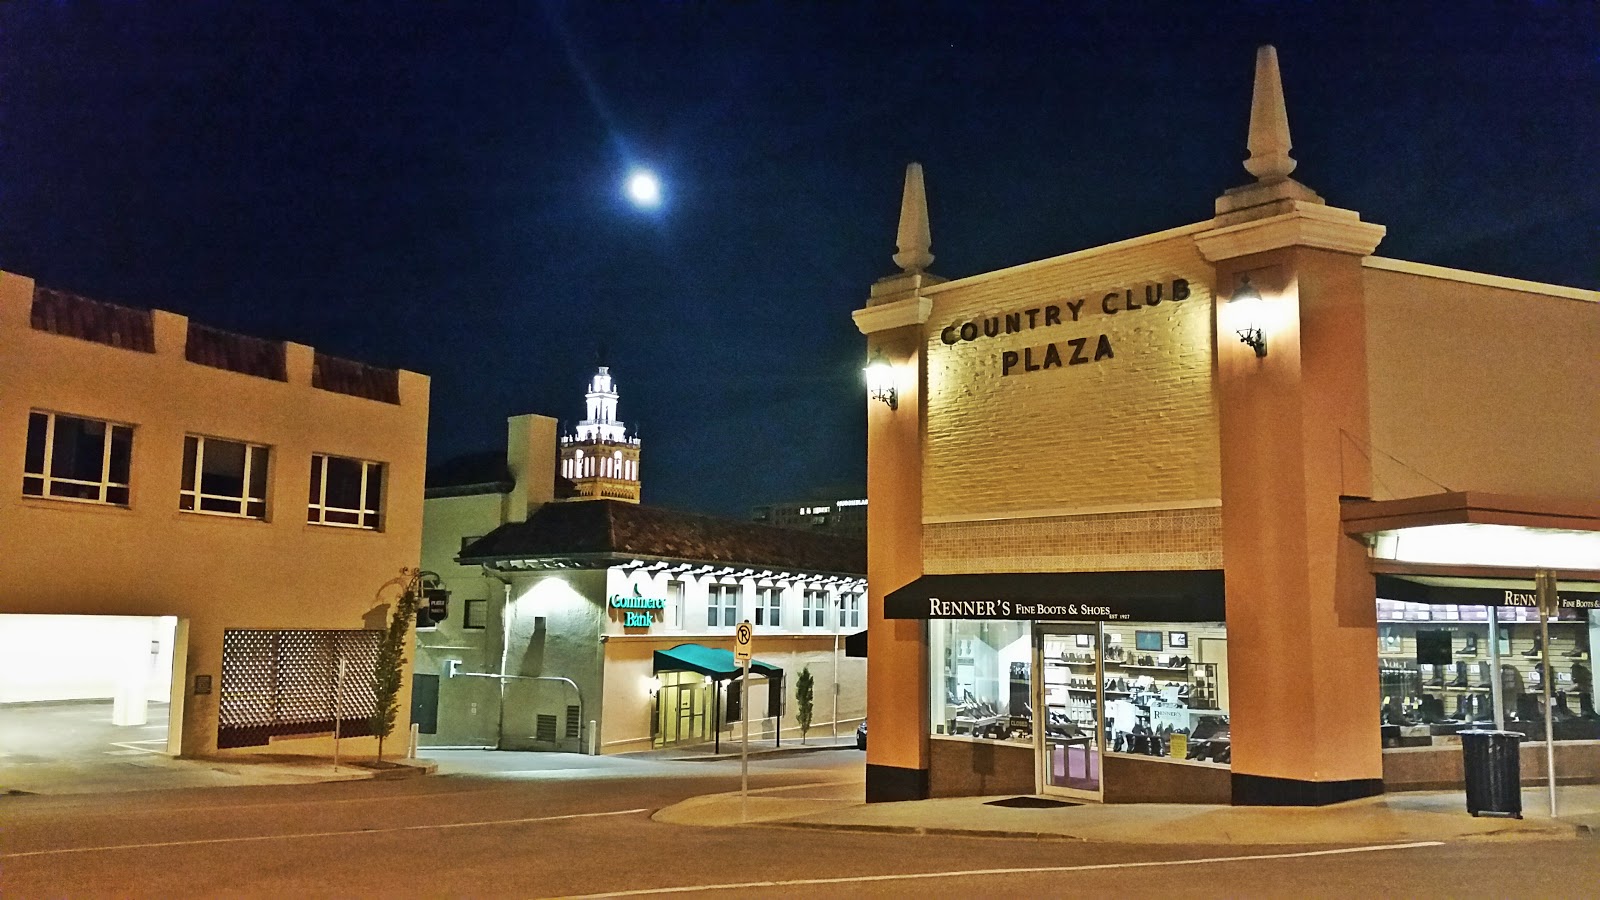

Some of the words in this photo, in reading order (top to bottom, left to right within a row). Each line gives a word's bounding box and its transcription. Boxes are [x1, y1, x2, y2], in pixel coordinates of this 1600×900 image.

[941, 299, 1084, 345] COUNTRY
[1101, 278, 1191, 315] CLUB
[1002, 334, 1114, 376] PLAZA
[609, 594, 666, 609] Commerce
[929, 598, 1011, 616] RENNER'S
[1015, 603, 1036, 615] FINE
[1037, 603, 1067, 615] BOOTS
[1068, 604, 1078, 615] &
[1080, 604, 1111, 616] SHOES
[1504, 590, 1560, 606] RENN
[1562, 599, 1575, 608] FINE
[1575, 599, 1593, 608] BOOTS
[624, 610, 653, 627] Bank
